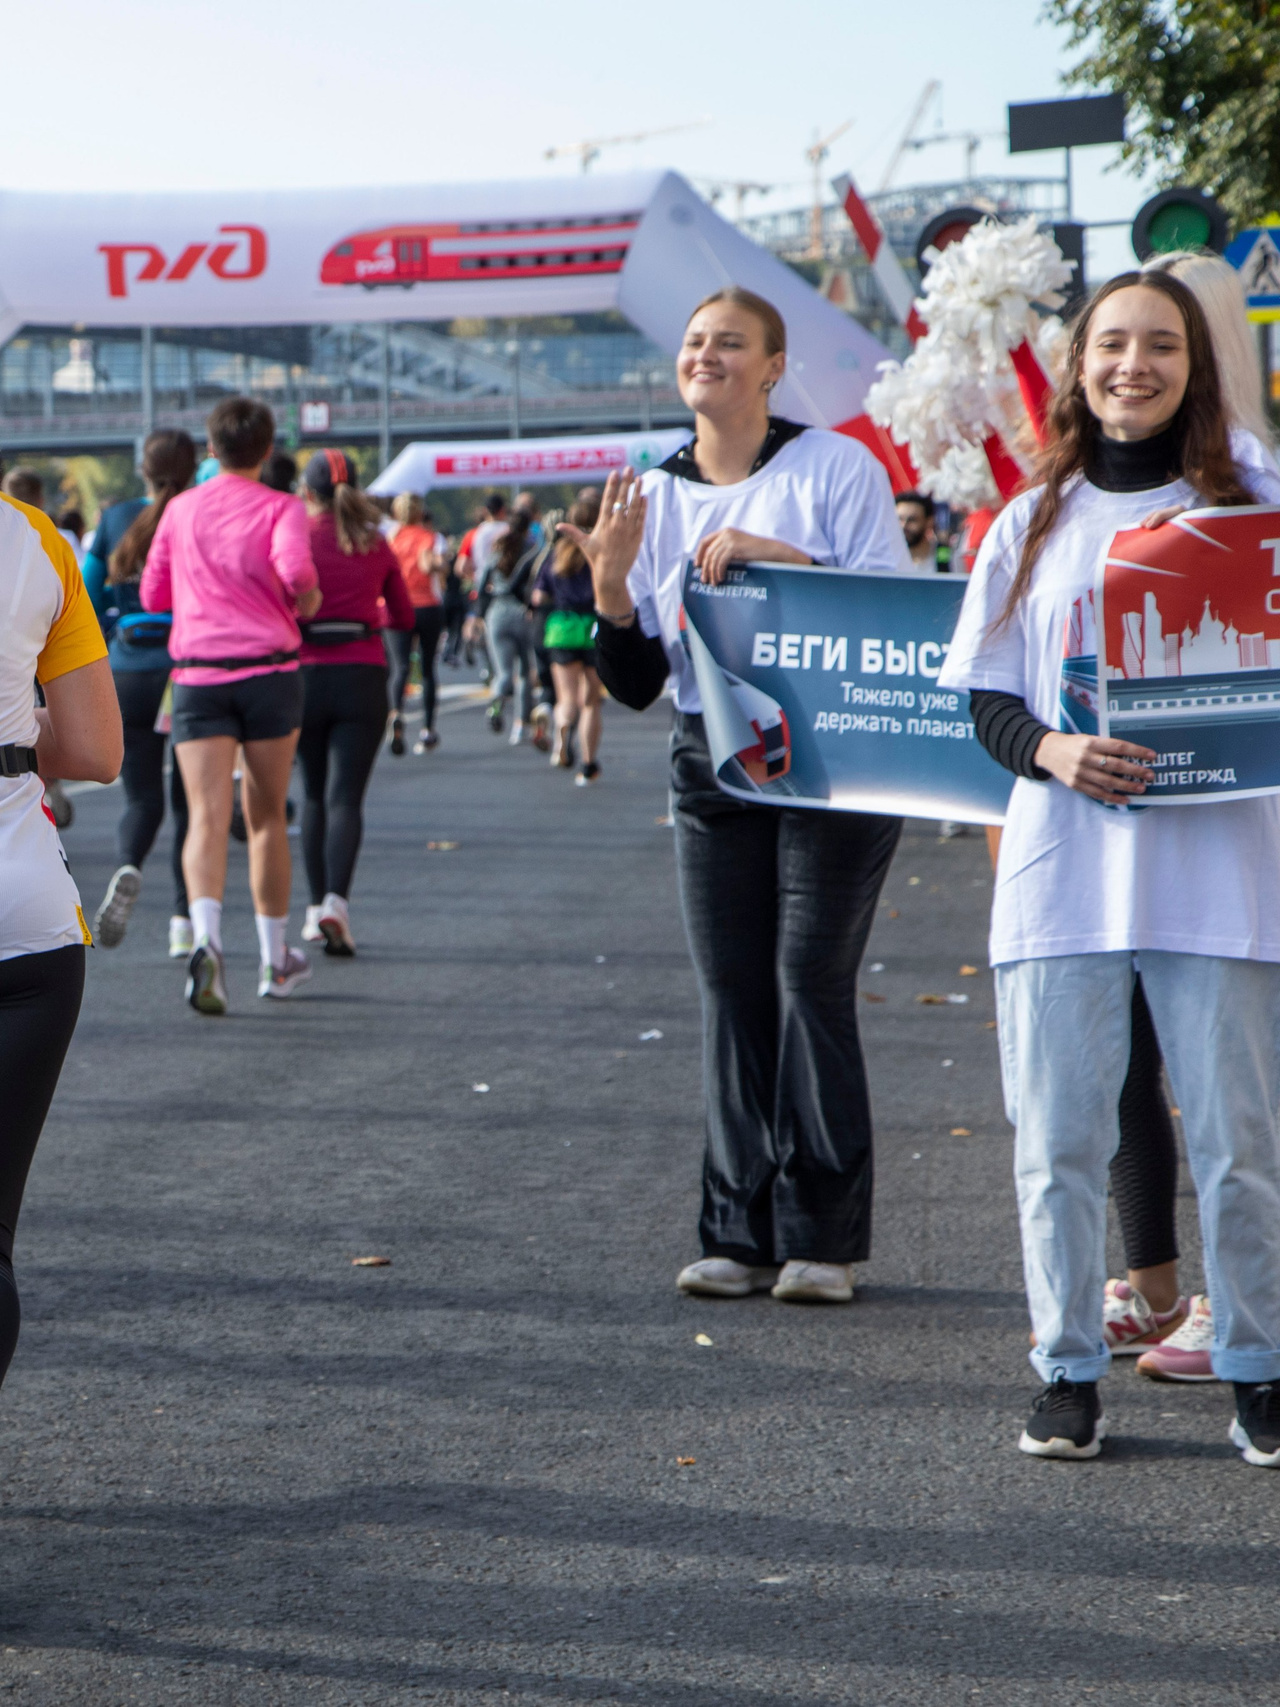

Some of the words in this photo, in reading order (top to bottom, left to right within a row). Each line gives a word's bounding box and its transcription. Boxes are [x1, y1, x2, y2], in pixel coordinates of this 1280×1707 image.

[751, 632, 848, 672] БЕГИ
[840, 681, 915, 708] Тяжело
[919, 691, 959, 714] уже
[814, 711, 902, 734] держать
[907, 717, 975, 740] плакат
